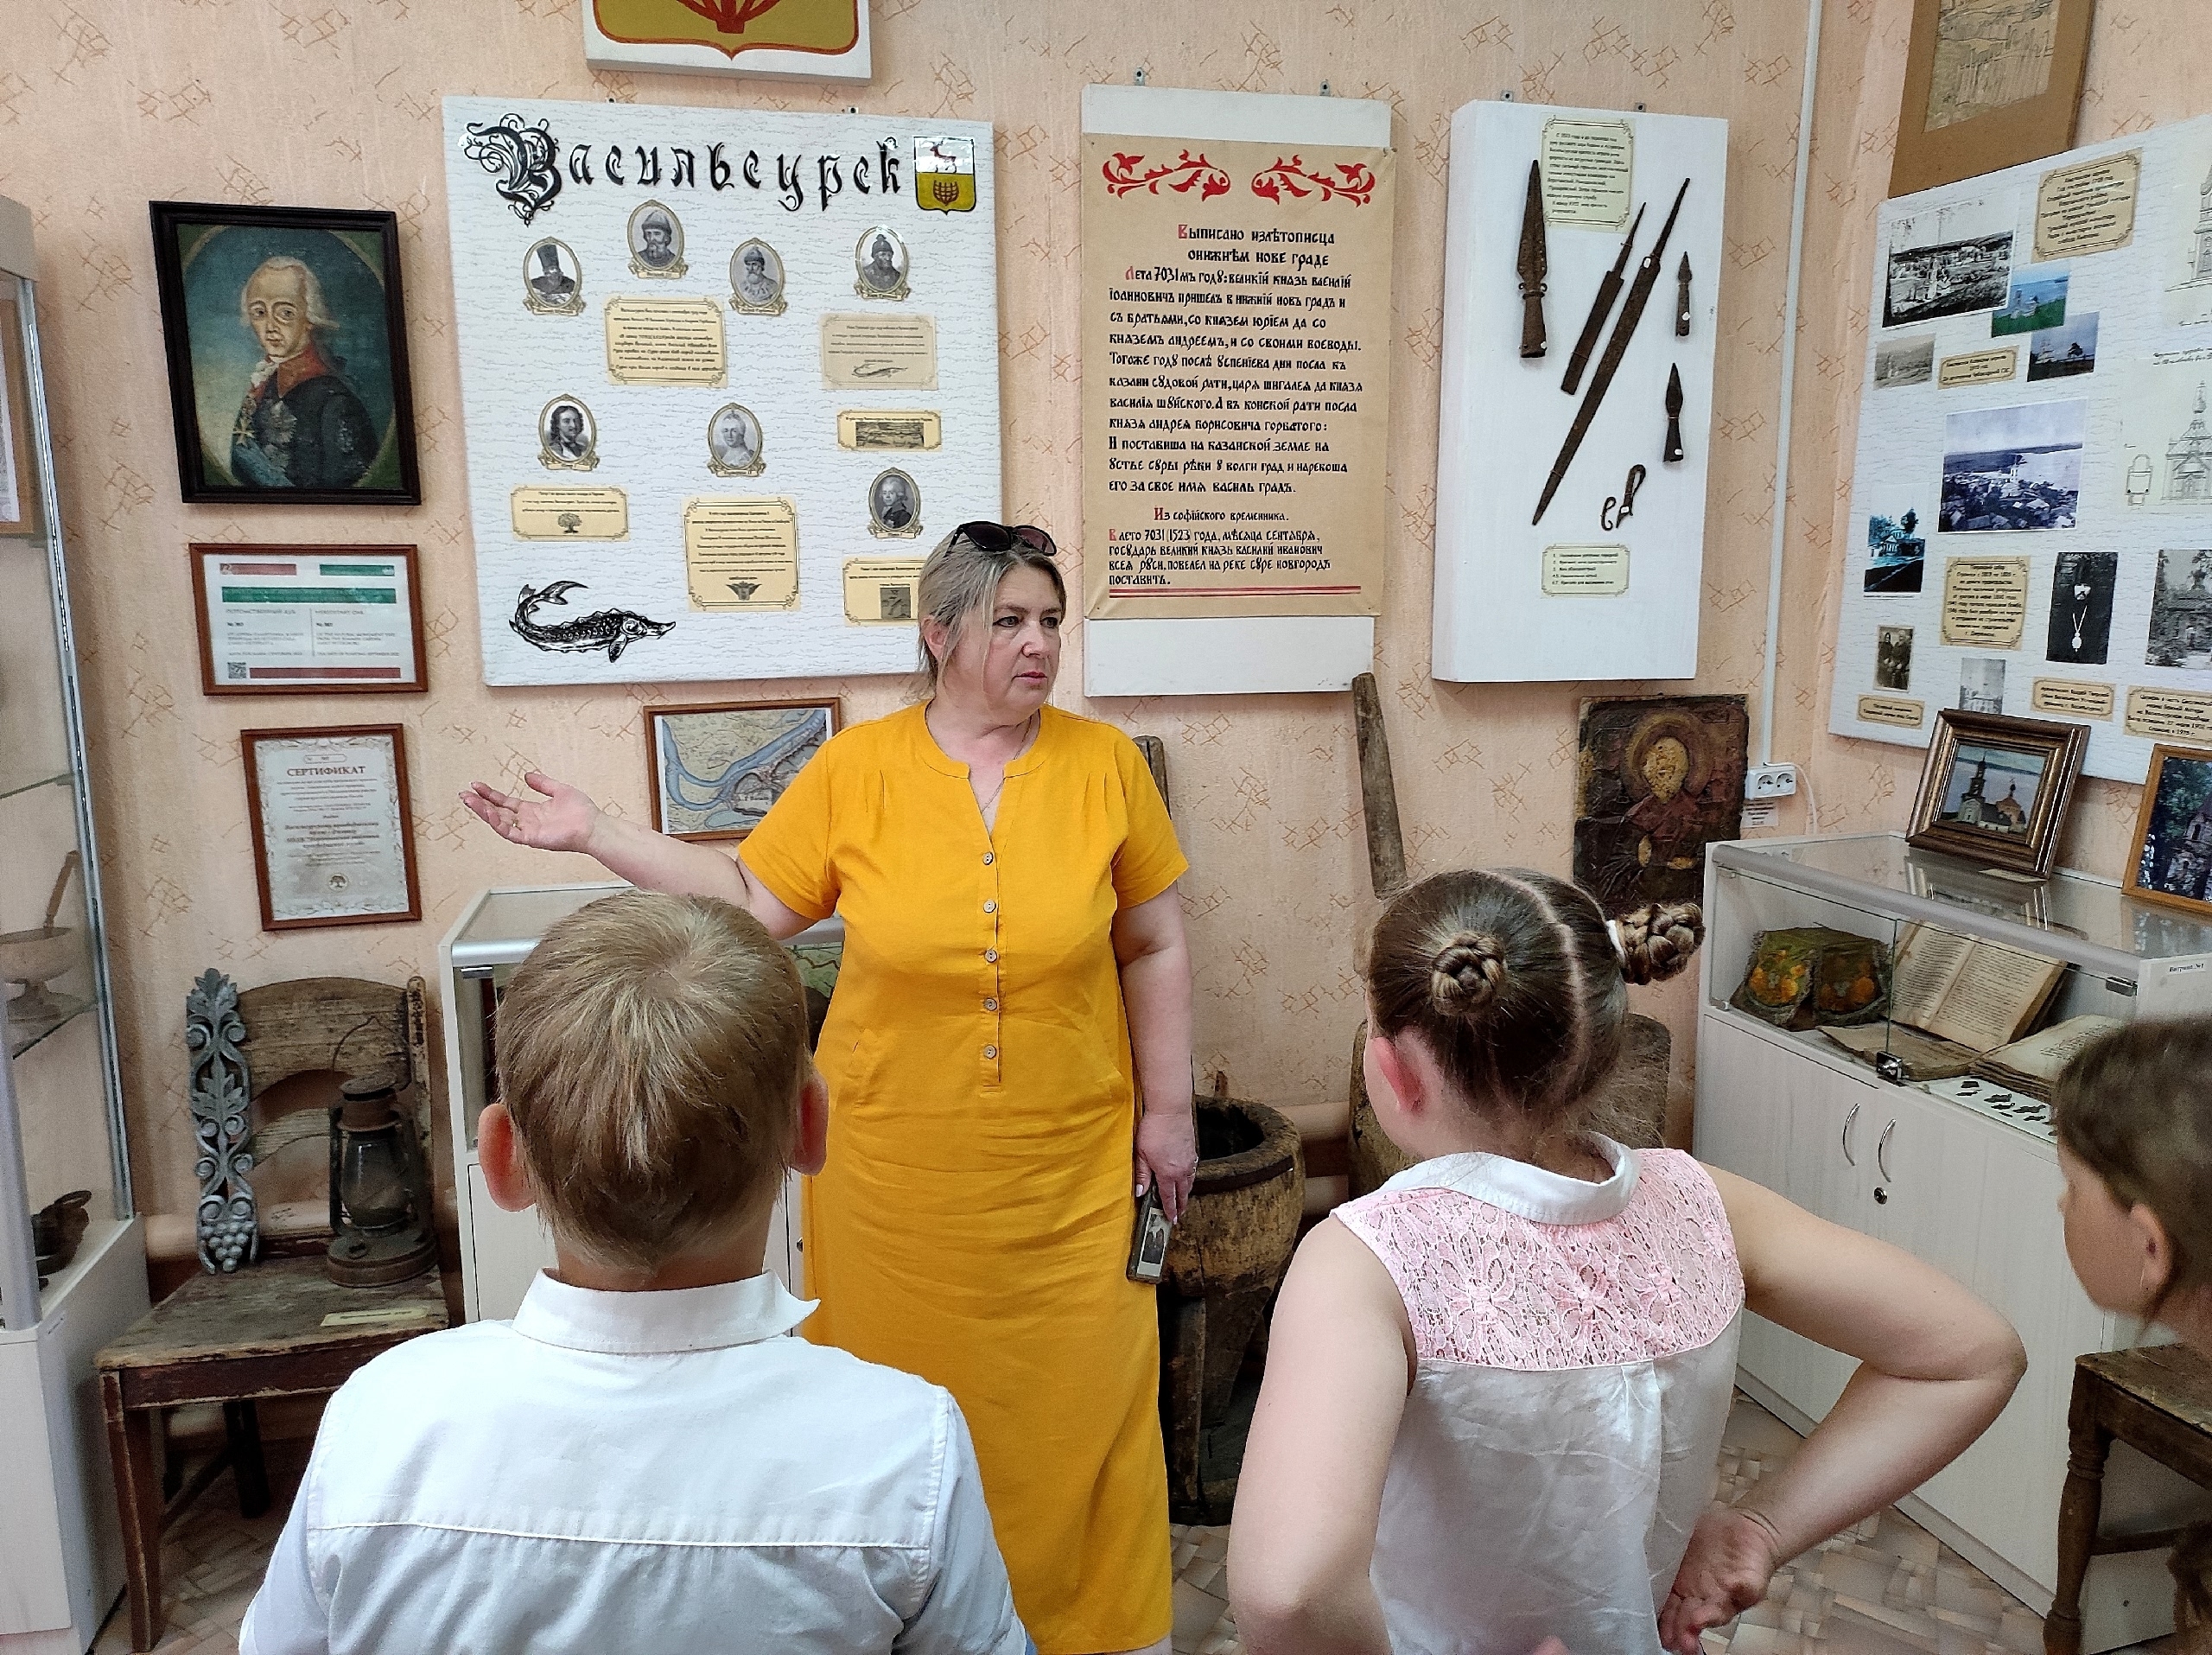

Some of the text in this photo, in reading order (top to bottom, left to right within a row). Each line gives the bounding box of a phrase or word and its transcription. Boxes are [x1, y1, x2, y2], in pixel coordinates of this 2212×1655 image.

[1179, 225, 1244, 240] Выписано
[1256, 252, 1286, 263] нове
[1292, 254, 1328, 271] граде
[1227, 295, 1232, 304] в
[1277, 296, 1301, 306] новъ
[1306, 297, 1335, 311] градъ
[1110, 312, 1122, 321] съ
[1293, 318, 1306, 330] да
[1313, 318, 1325, 328] со
[1241, 337, 1254, 347] со
[1259, 338, 1302, 348] своими
[1332, 361, 1346, 370] къ
[1109, 378, 1148, 387] казани
[1314, 382, 1326, 392] да
[1227, 400, 1240, 409] въ
[1293, 401, 1320, 414] рати
[1122, 440, 1186, 449] поставиша
[1191, 441, 1204, 450] на
[1273, 442, 1310, 451] земле
[1315, 442, 1329, 451] на
[1226, 462, 1256, 471] волги
[1109, 481, 1127, 491] его
[1129, 481, 1145, 491] за
[1148, 481, 1173, 491] свое
[1154, 507, 1170, 520] Из
[1119, 532, 1141, 541] лето
[1145, 529, 1164, 541] 7031
[1209, 561, 1221, 570] на
[1223, 560, 1246, 573] реке
[287, 766, 366, 777] СЕРТИФИКАТ
